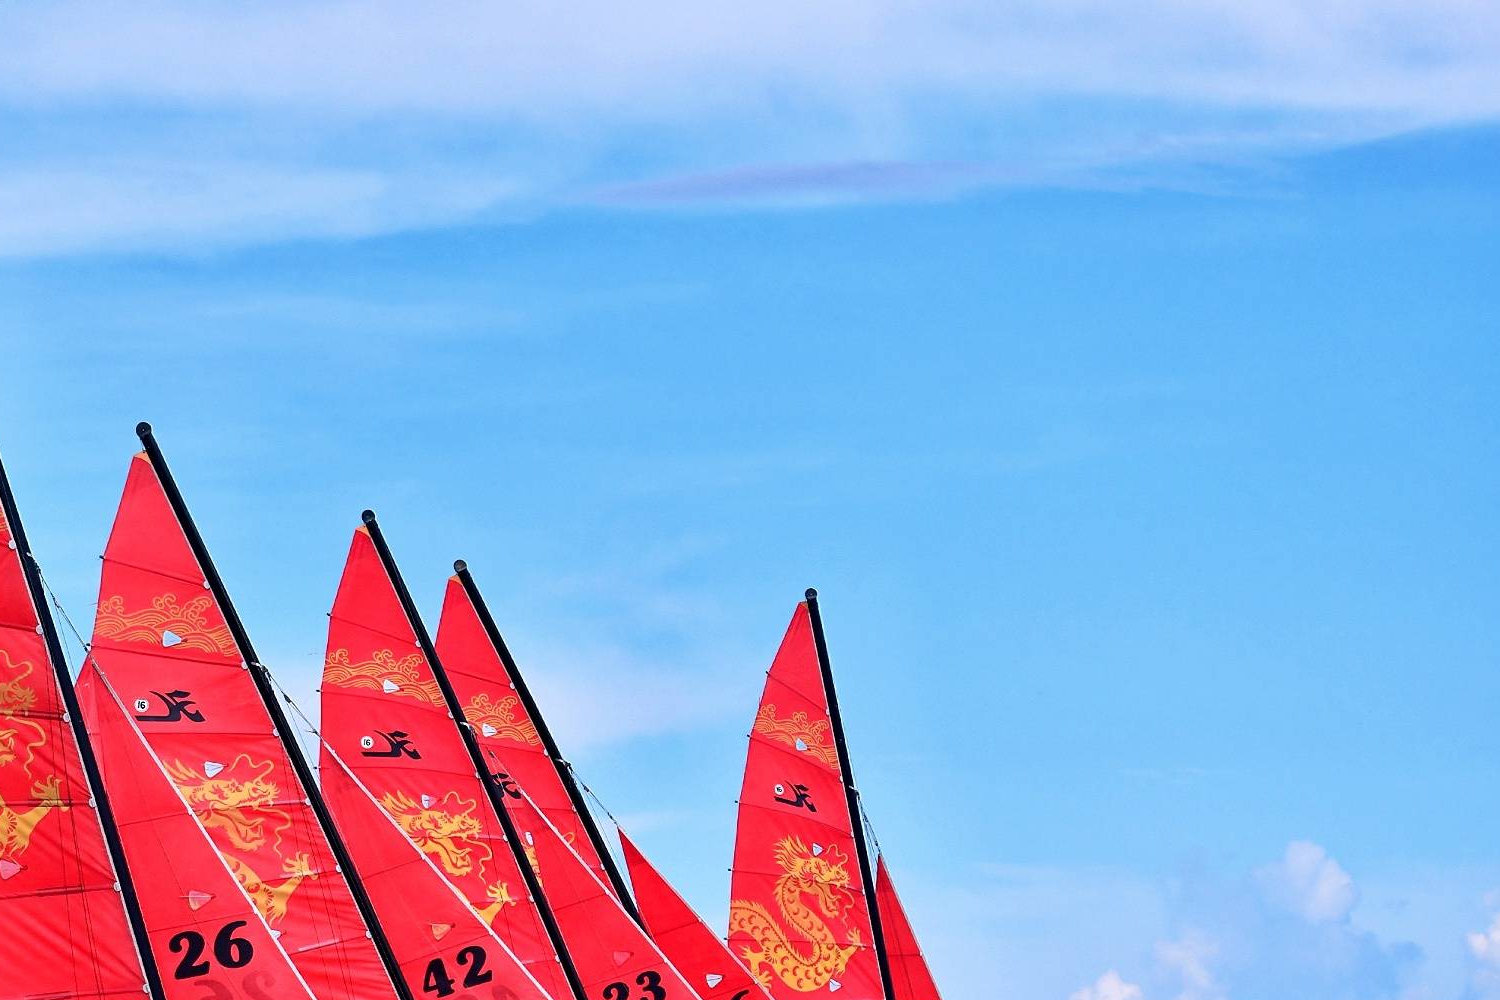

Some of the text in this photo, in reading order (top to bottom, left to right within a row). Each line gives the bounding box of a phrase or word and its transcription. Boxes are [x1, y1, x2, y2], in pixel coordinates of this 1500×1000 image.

[137, 700, 146, 710] 16
[363, 738, 371, 747] 16
[169, 920, 254, 980] 26
[422, 945, 493, 998] 42
